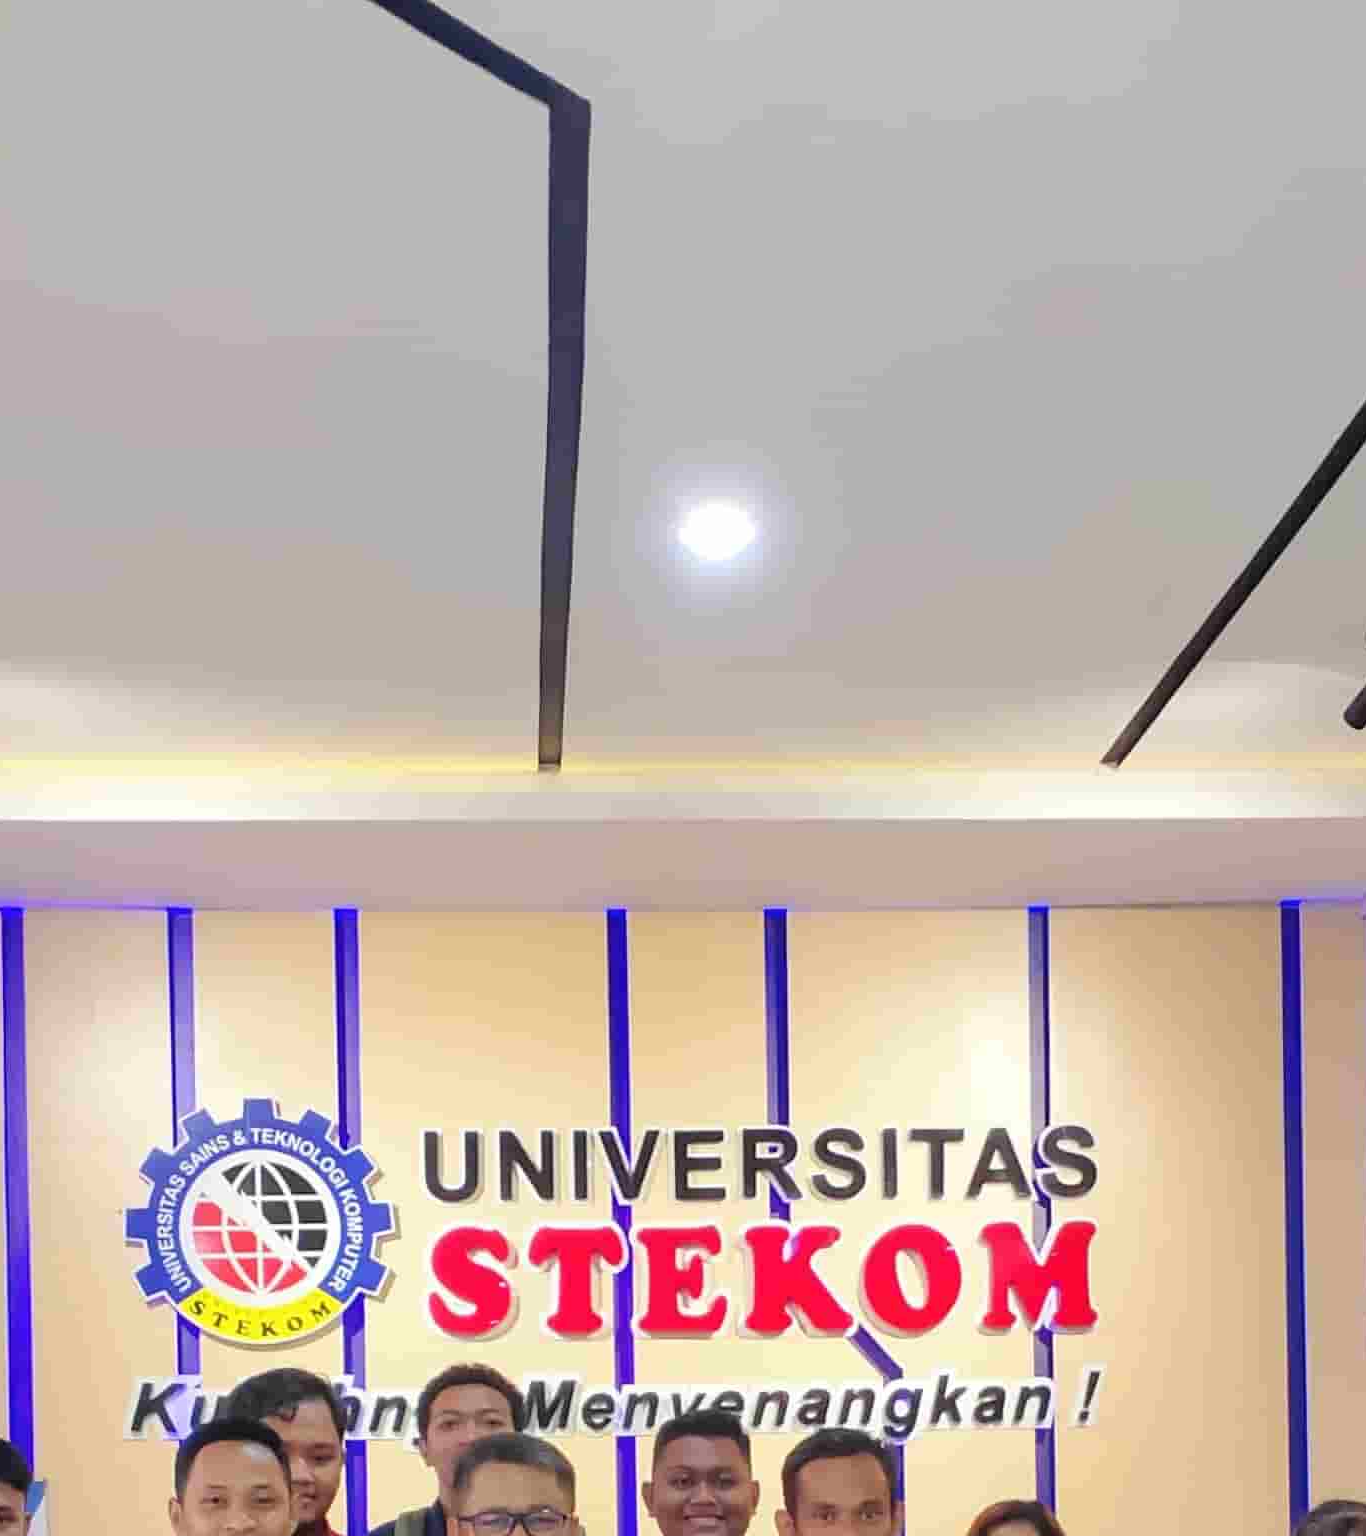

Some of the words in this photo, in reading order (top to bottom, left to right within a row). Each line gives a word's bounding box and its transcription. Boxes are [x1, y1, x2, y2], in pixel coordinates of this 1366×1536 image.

[423, 1125, 1098, 1201] UNIVERSITAS
[157, 1174, 192, 1293] UNIVERSITAS
[179, 1131, 231, 1176] SAINS
[233, 1129, 246, 1147] &
[250, 1127, 350, 1191] TEKNOLOGI
[327, 1188, 365, 1292] KOMPUTER
[429, 1222, 1098, 1336] STEKOM
[191, 1300, 332, 1337] STEKOM
[523, 1374, 1051, 1438] Menyenangkan
